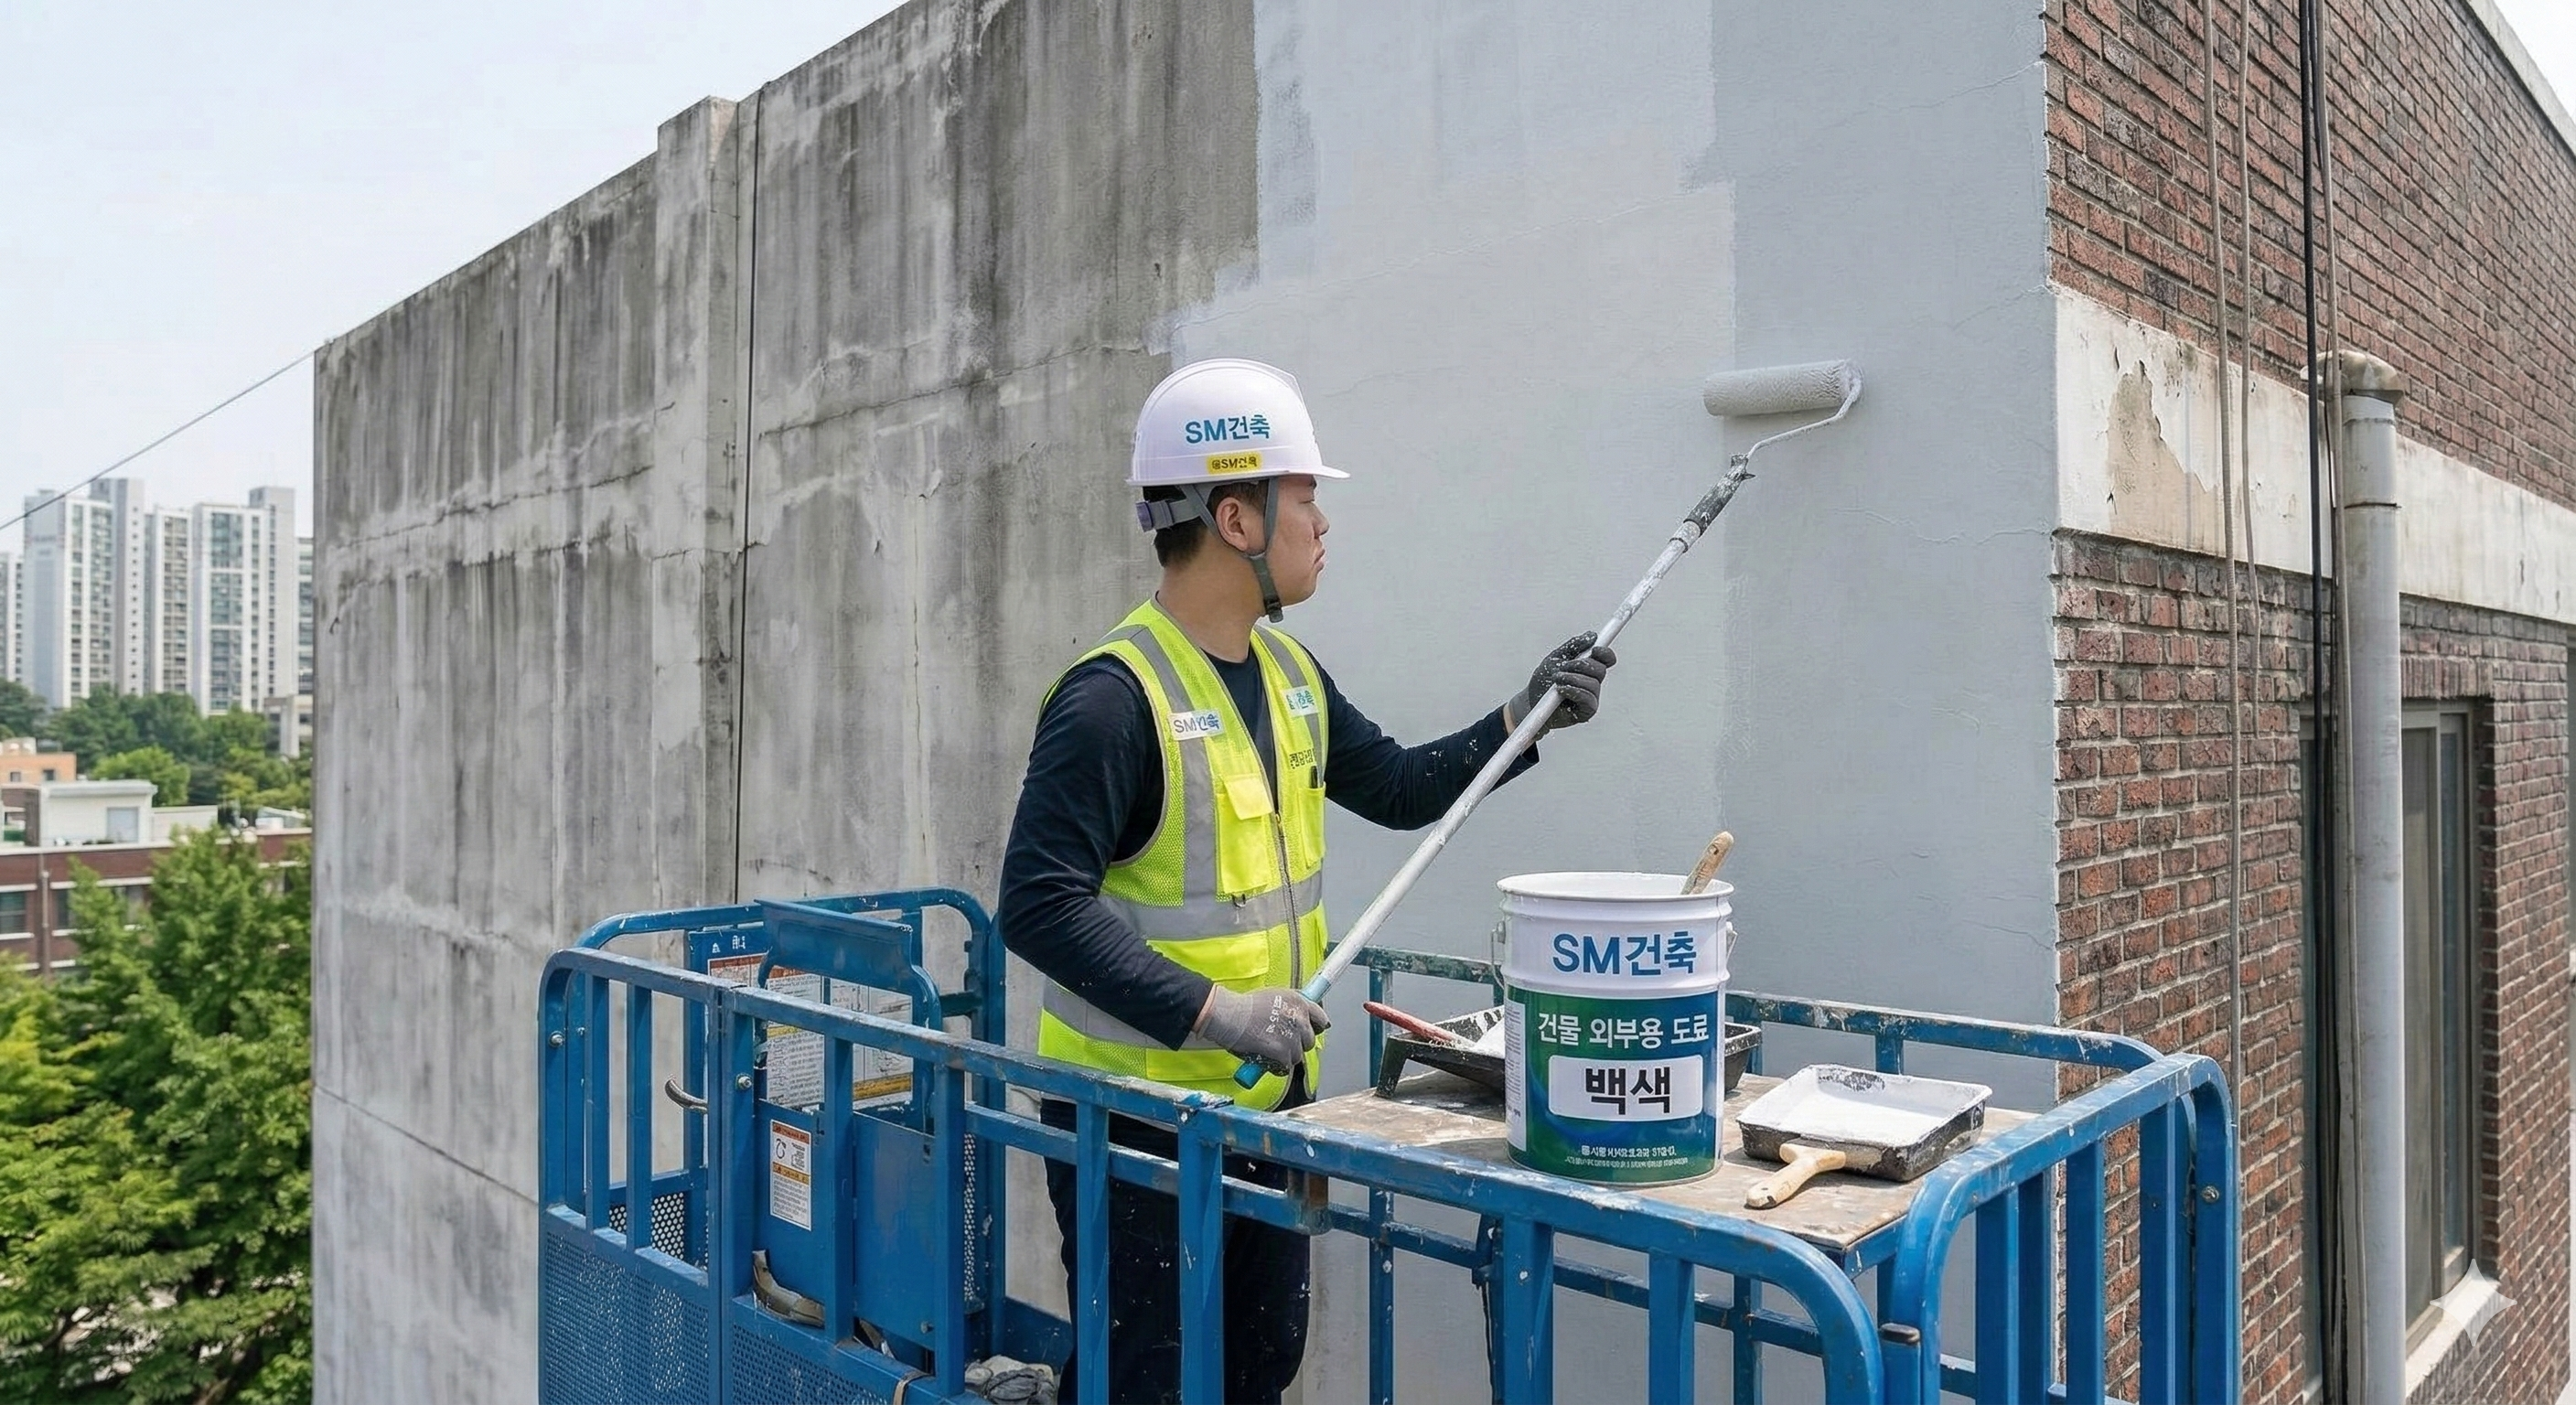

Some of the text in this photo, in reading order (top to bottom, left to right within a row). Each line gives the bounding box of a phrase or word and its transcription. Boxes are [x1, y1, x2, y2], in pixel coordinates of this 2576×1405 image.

[1186, 414, 1271, 444] SM건축
[1552, 931, 1697, 976] SM건축
[1539, 1013, 1582, 1046] 건물
[1589, 1017, 1664, 1049] 외부용
[1670, 1014, 1710, 1045] 도료
[1585, 1067, 1671, 1115] 백색
